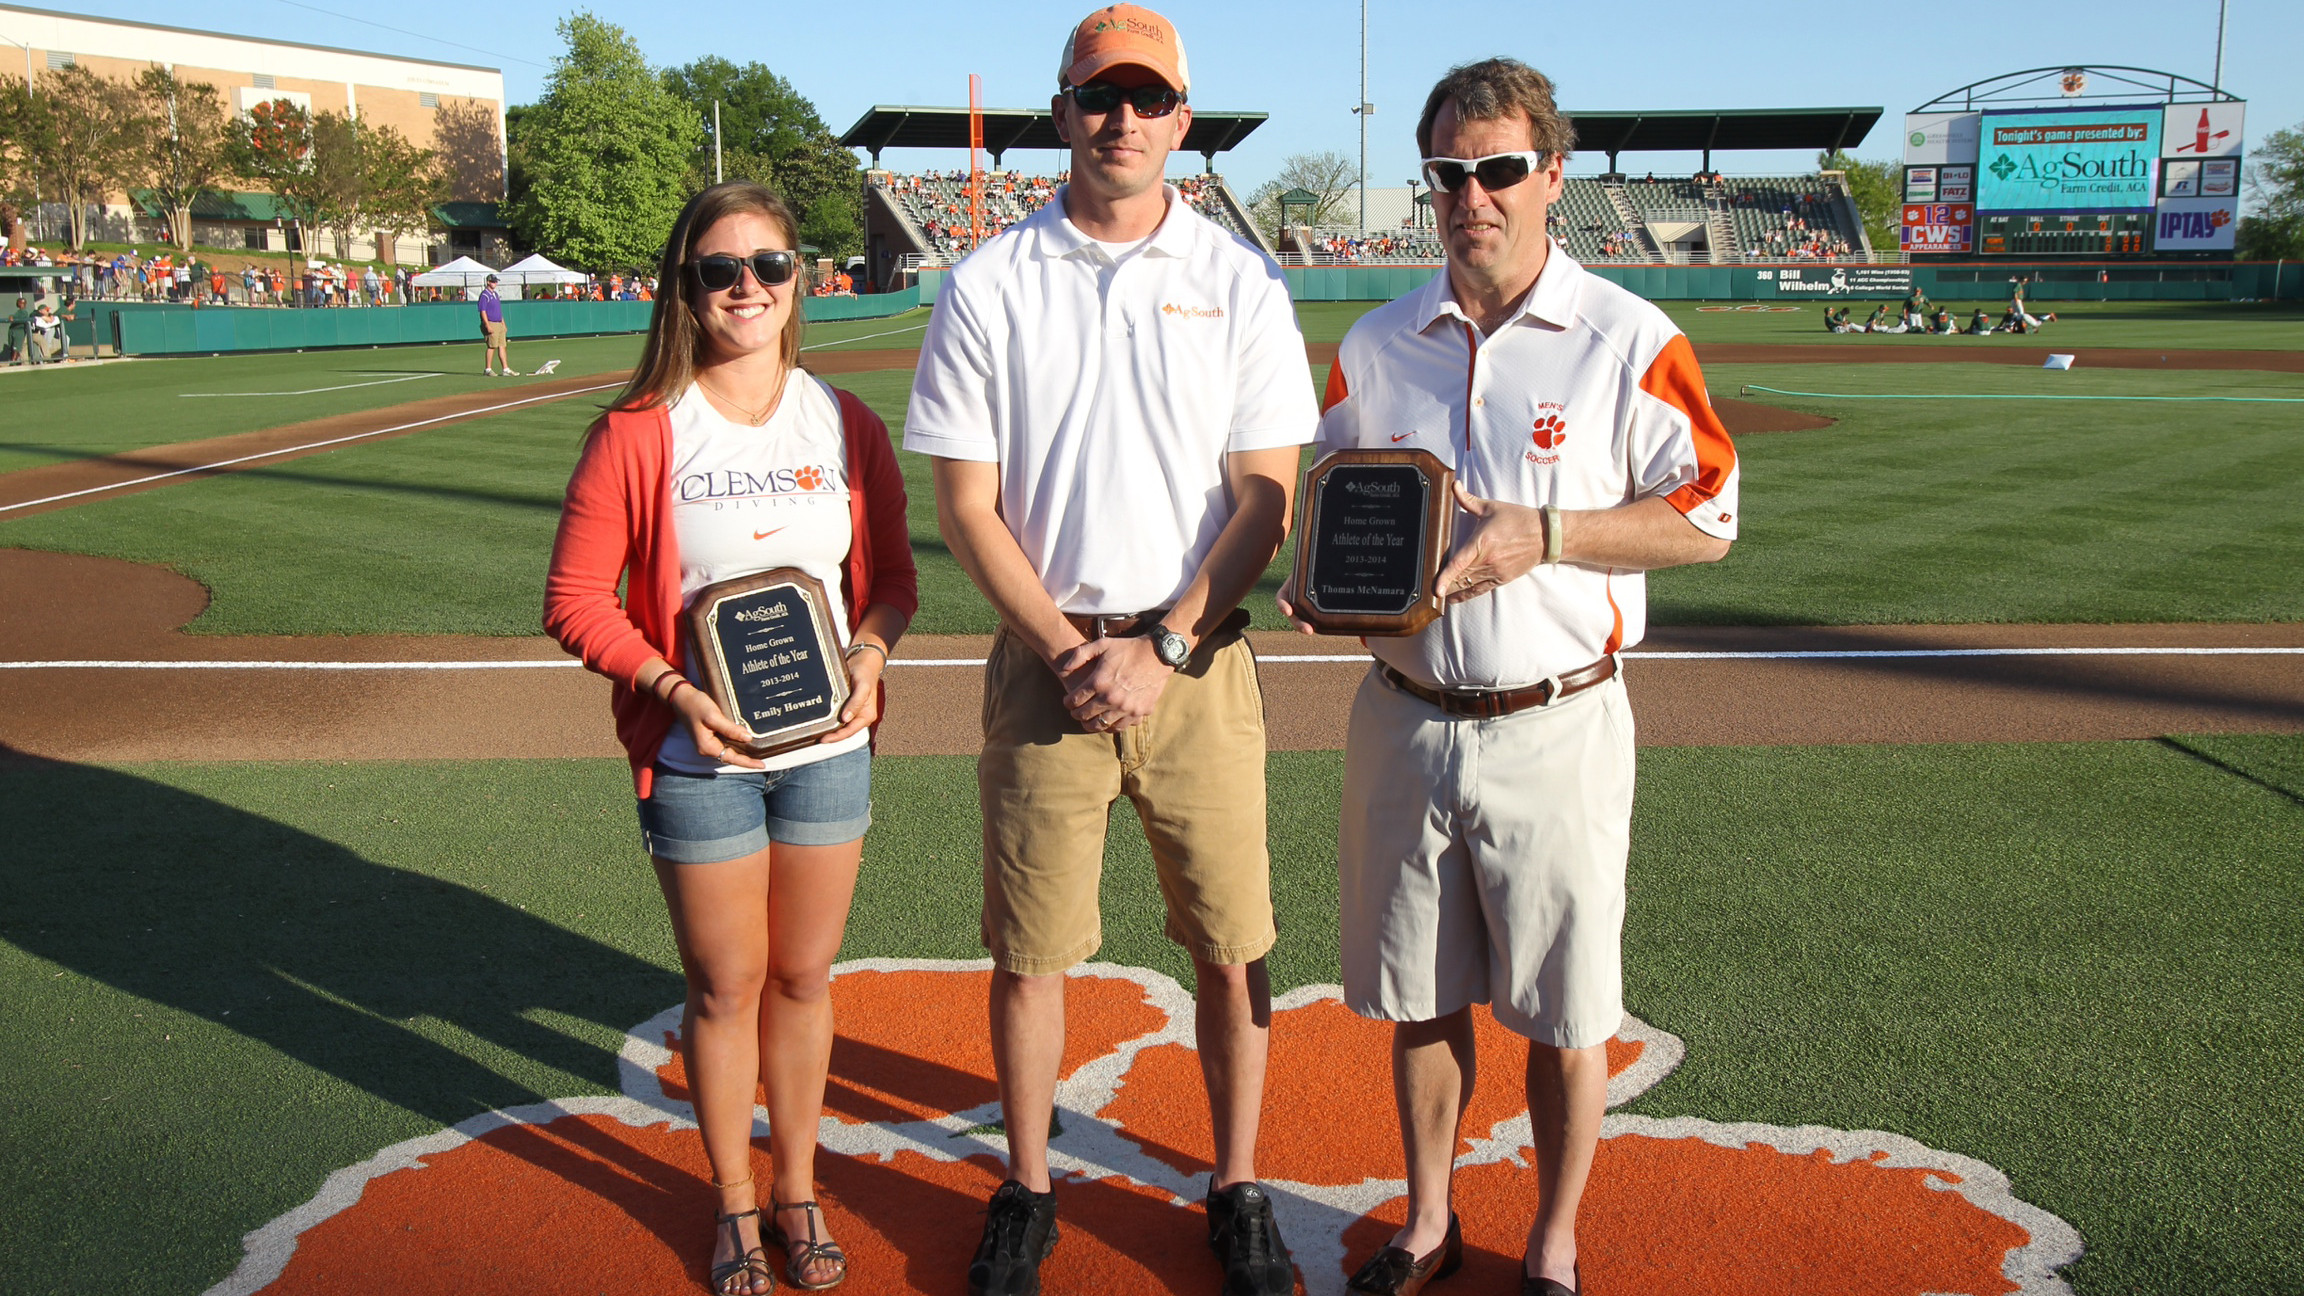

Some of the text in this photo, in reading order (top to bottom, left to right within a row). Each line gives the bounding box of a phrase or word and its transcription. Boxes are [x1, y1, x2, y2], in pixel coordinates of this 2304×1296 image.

[1105, 17, 1163, 39] AgSouth
[1997, 126, 2143, 144] Tonight's game presented by:
[2015, 150, 2147, 189] AgSouth
[1942, 187, 1968, 196] FATZ
[2061, 181, 2147, 194] Farm Credit, ACA
[1925, 205, 1951, 226] 12
[2160, 212, 2217, 239] IPTAY
[1911, 226, 1961, 244] CWS
[1757, 270, 1773, 280] 360
[1780, 269, 1800, 280] Bill
[1779, 281, 1830, 291] Wilhelm
[1175, 304, 1224, 319] AgSouth
[1538, 402, 1564, 412] MEN'S
[1525, 451, 1560, 465] SOCCER
[1354, 481, 1401, 496] AgSouth
[715, 496, 816, 511] DIVING
[1343, 516, 1396, 526] Home Grown
[1331, 533, 1404, 547] Athlete of the Year
[1345, 555, 1388, 564] 2013-2014
[1321, 584, 1405, 596] Thomas McNamara
[745, 601, 788, 622] AgSouth
[745, 635, 795, 653] Home Grown
[742, 649, 808, 675] Athlete of the Year
[760, 671, 800, 688] 2013-2014
[753, 695, 823, 720] Emily Howard
